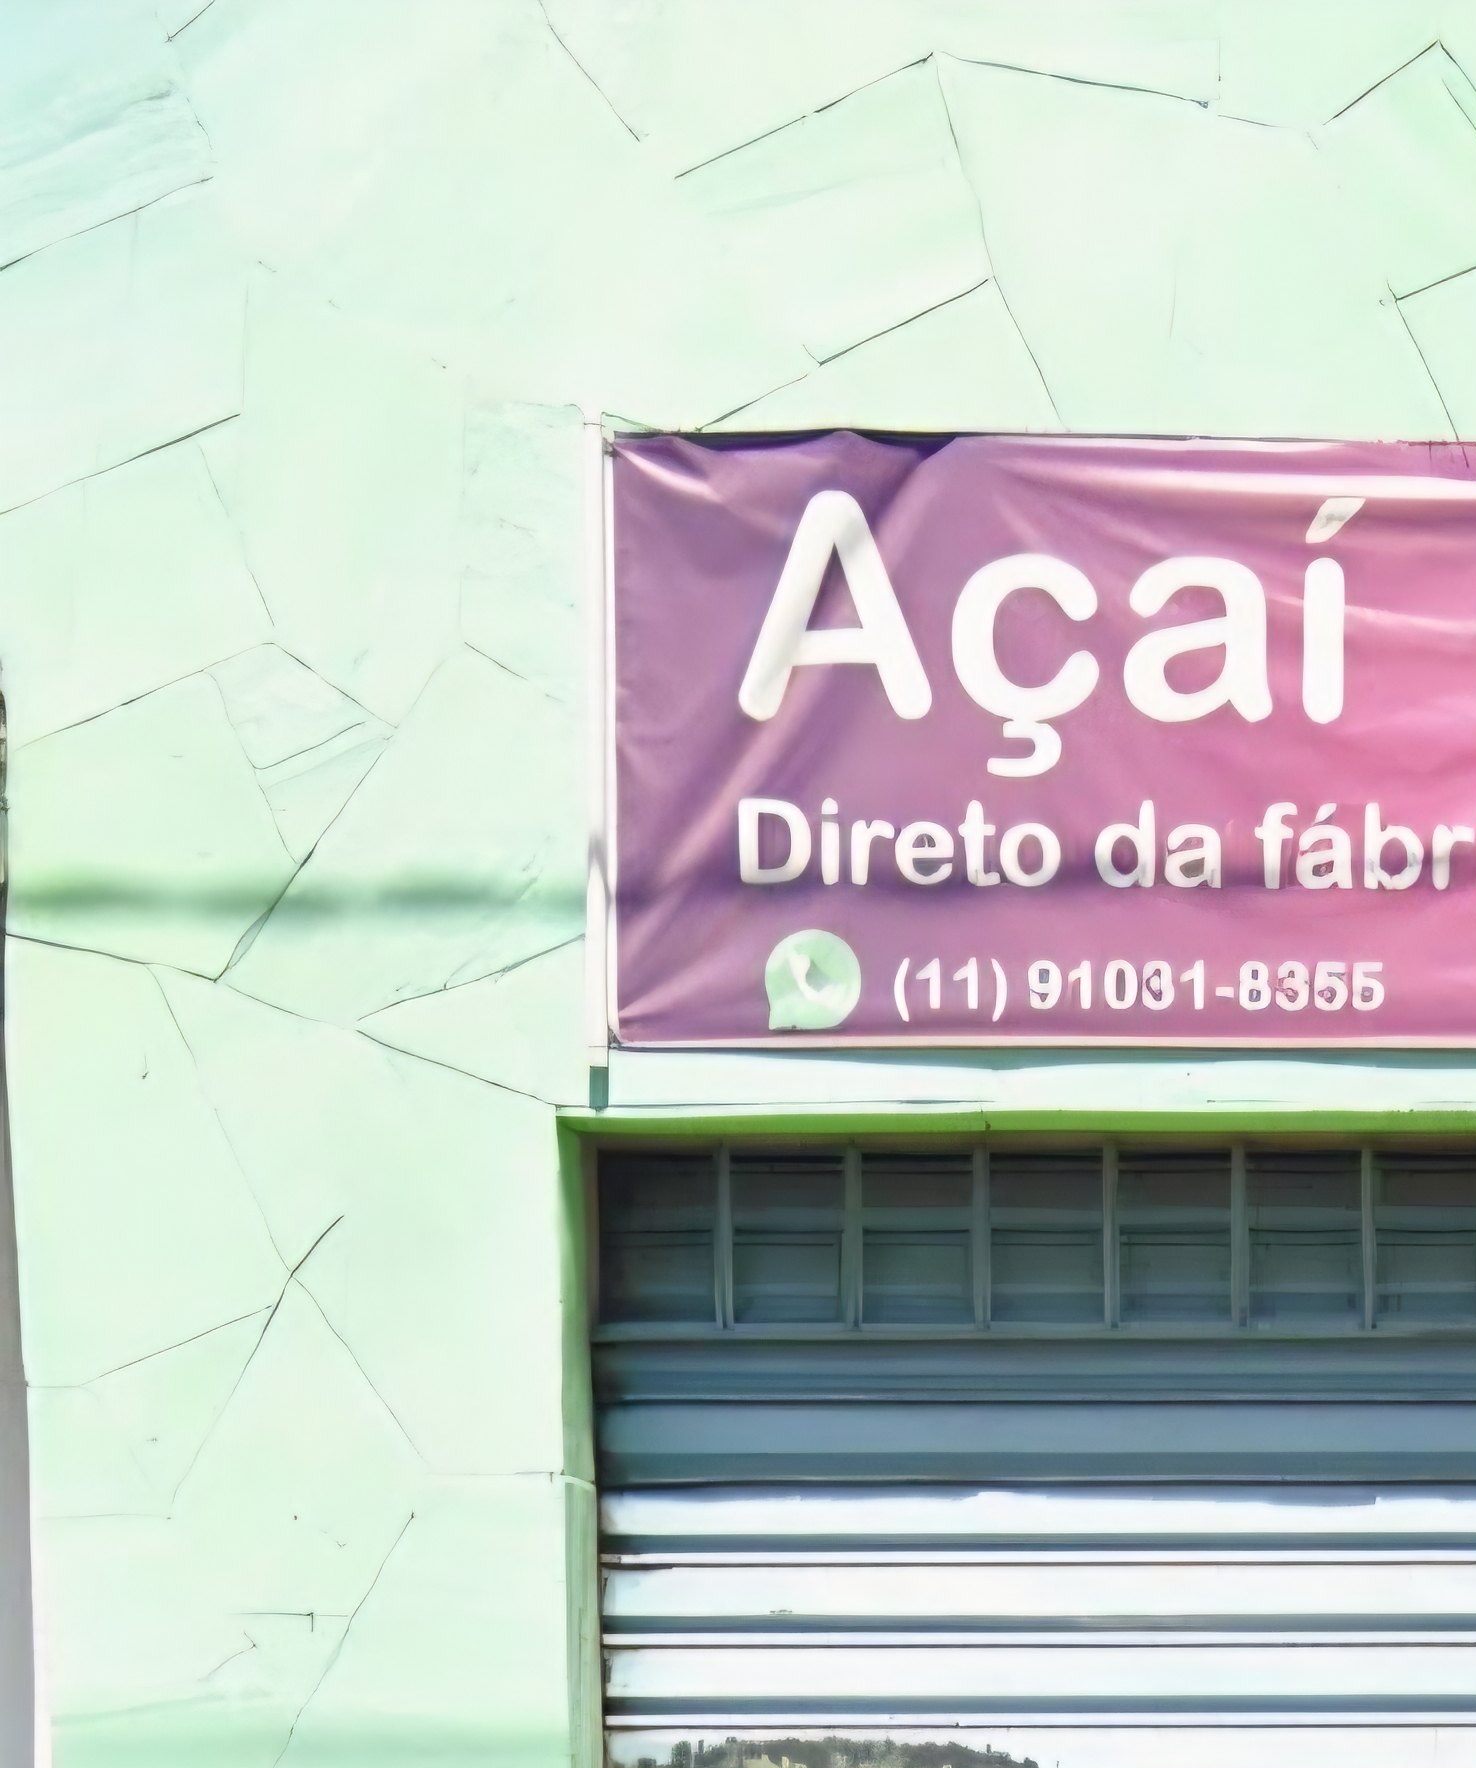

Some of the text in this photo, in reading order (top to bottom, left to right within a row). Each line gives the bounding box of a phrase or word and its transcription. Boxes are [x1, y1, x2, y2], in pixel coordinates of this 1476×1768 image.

[737, 489, 1367, 777] Açaí
[738, 798, 1061, 886] Direto
[1094, 799, 1222, 889] da
[893, 956, 1008, 1022] (11)
